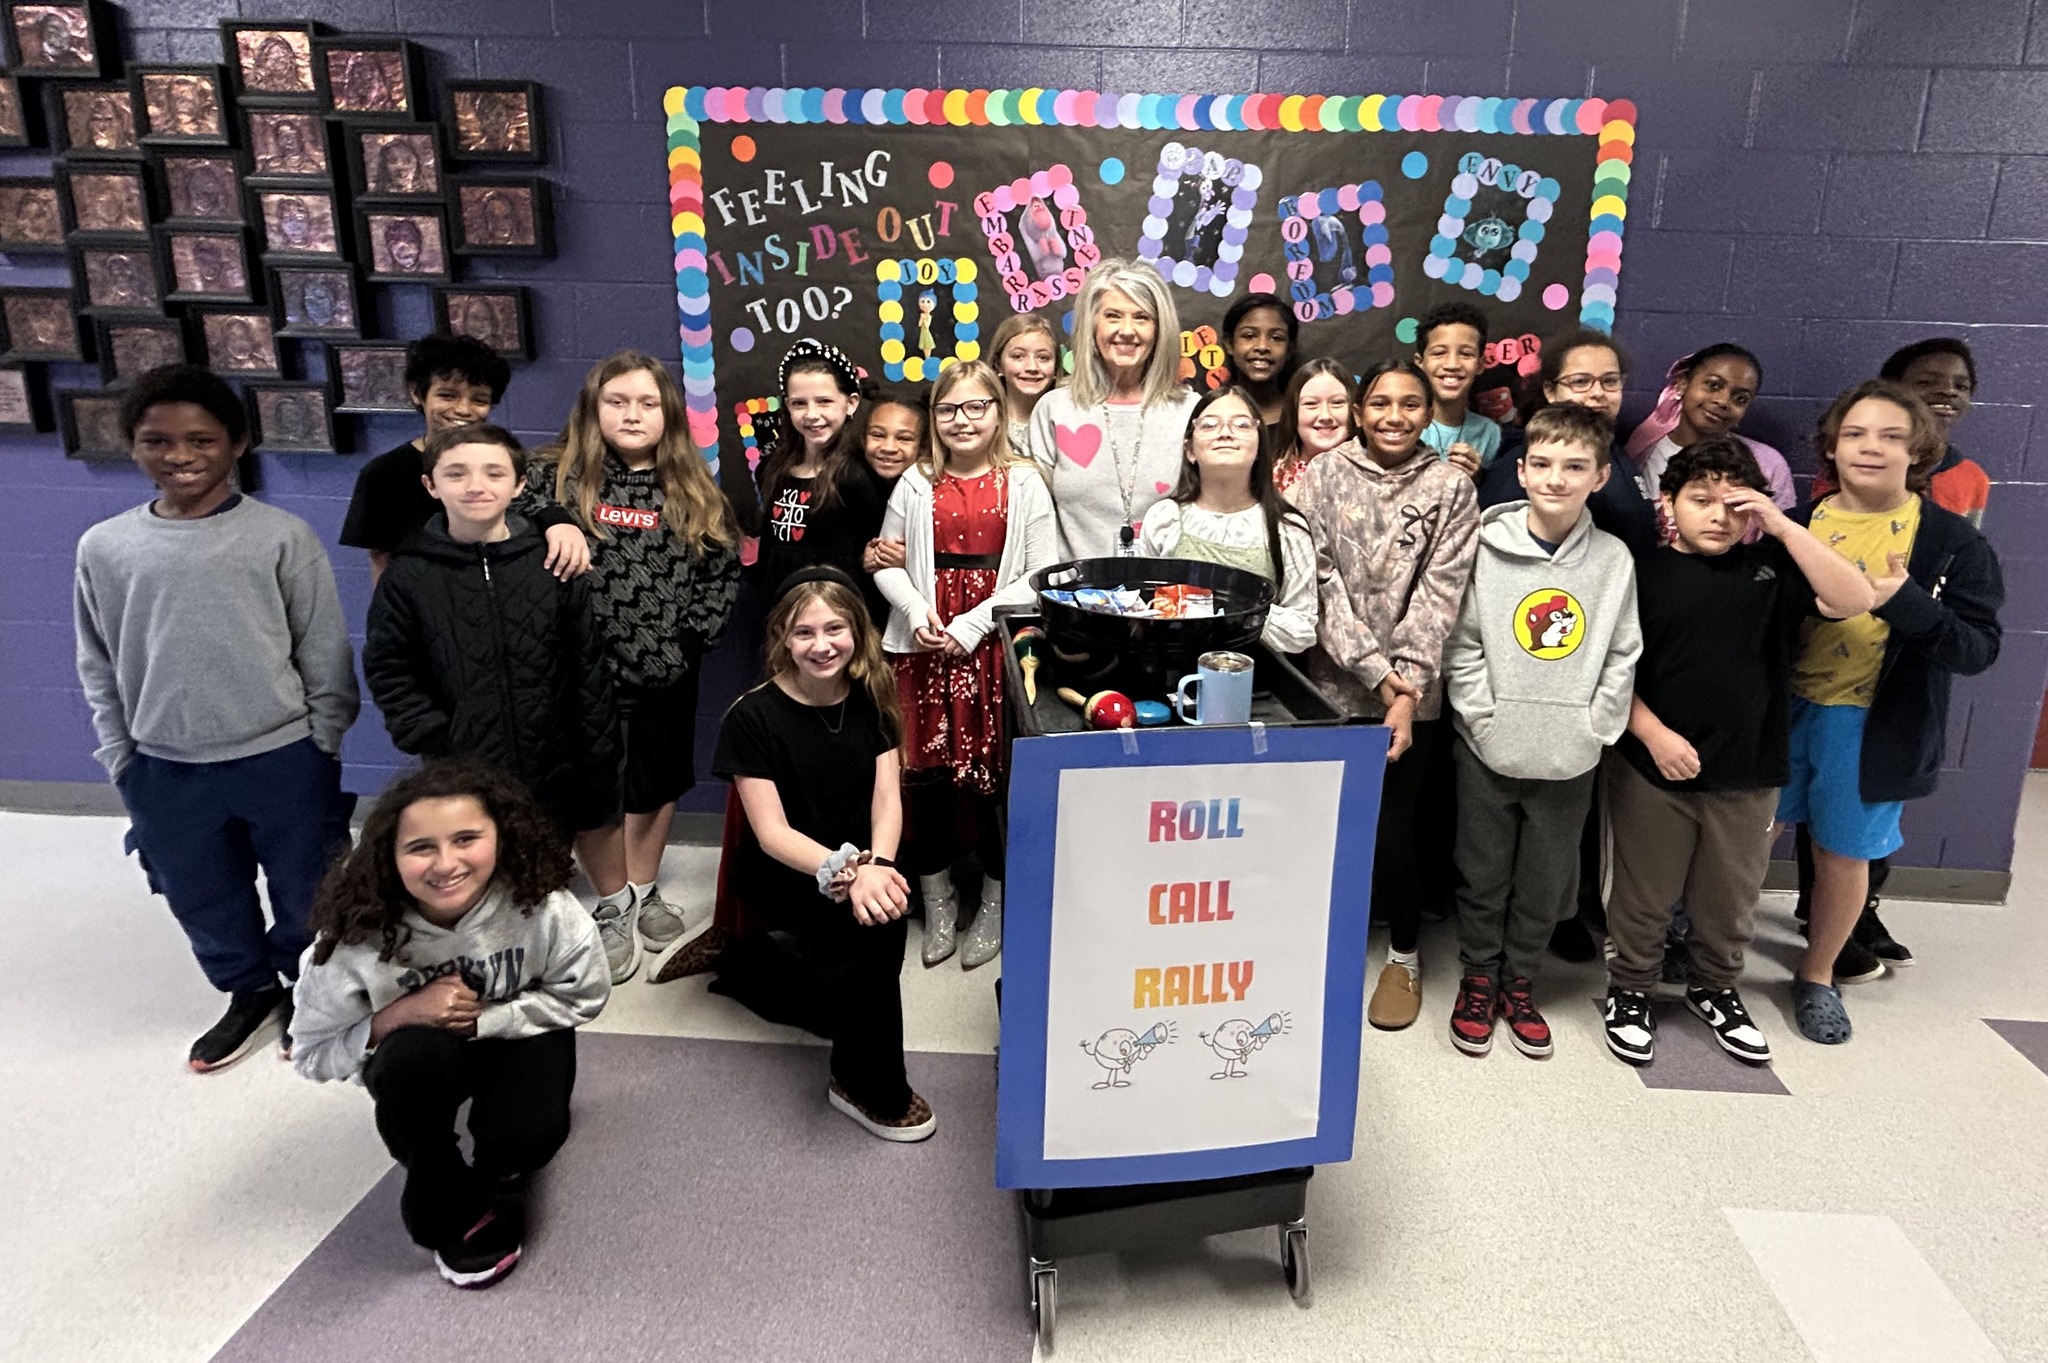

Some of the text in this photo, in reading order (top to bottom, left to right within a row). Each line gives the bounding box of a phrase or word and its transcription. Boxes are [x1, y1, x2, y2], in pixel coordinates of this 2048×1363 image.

[710, 150, 891, 226] FEELING
[1466, 156, 1538, 193] ENVY
[709, 200, 958, 286] INSIDE OUT
[901, 262, 952, 281] JOY
[745, 286, 853, 333] TOO?
[1149, 798, 1244, 842] ROLL
[1149, 880, 1234, 925] CALL
[1133, 960, 1254, 1009] RALLY
